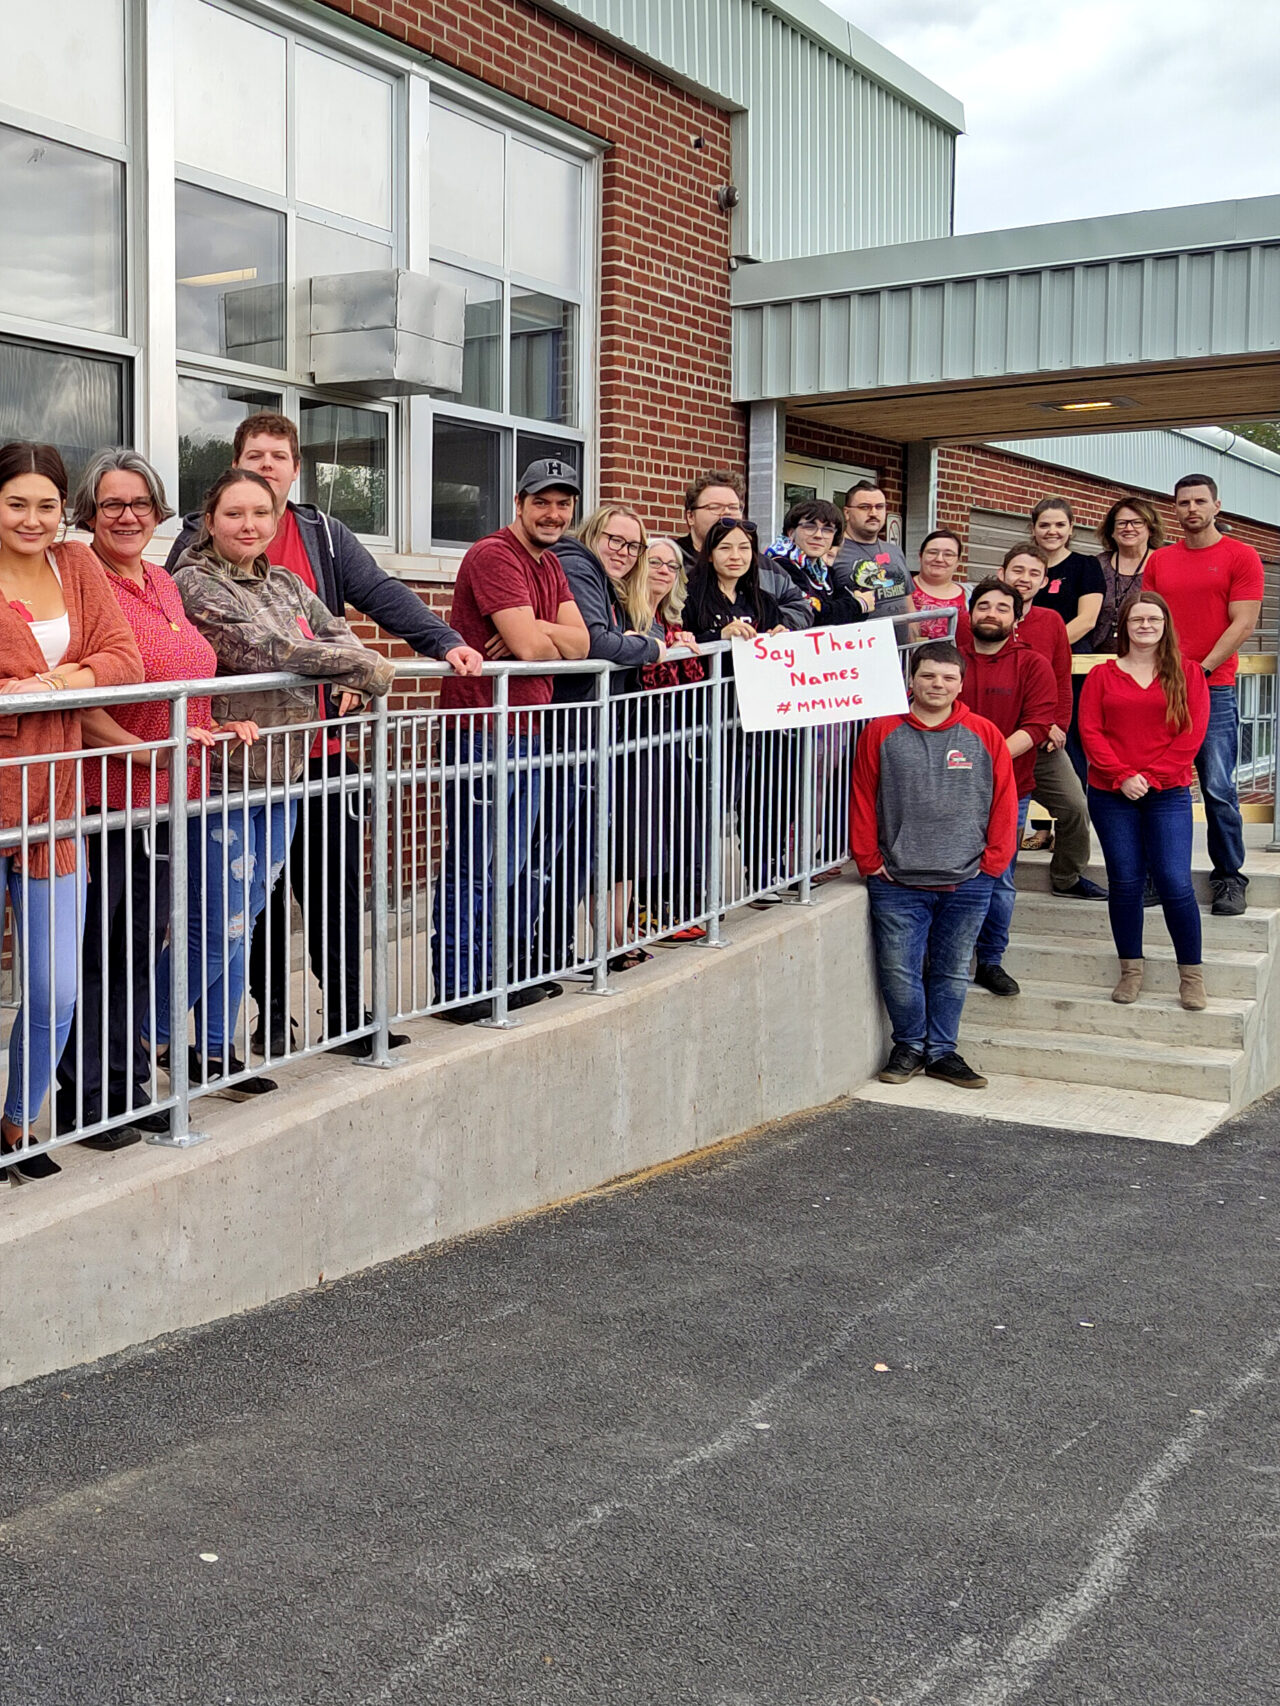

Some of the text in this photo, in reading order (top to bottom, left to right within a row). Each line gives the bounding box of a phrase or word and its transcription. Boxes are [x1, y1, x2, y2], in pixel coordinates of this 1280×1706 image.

[546, 461, 563, 477] H
[753, 628, 876, 668] Say Their
[790, 667, 859, 687] Names
[776, 694, 863, 715] #MMIWG
